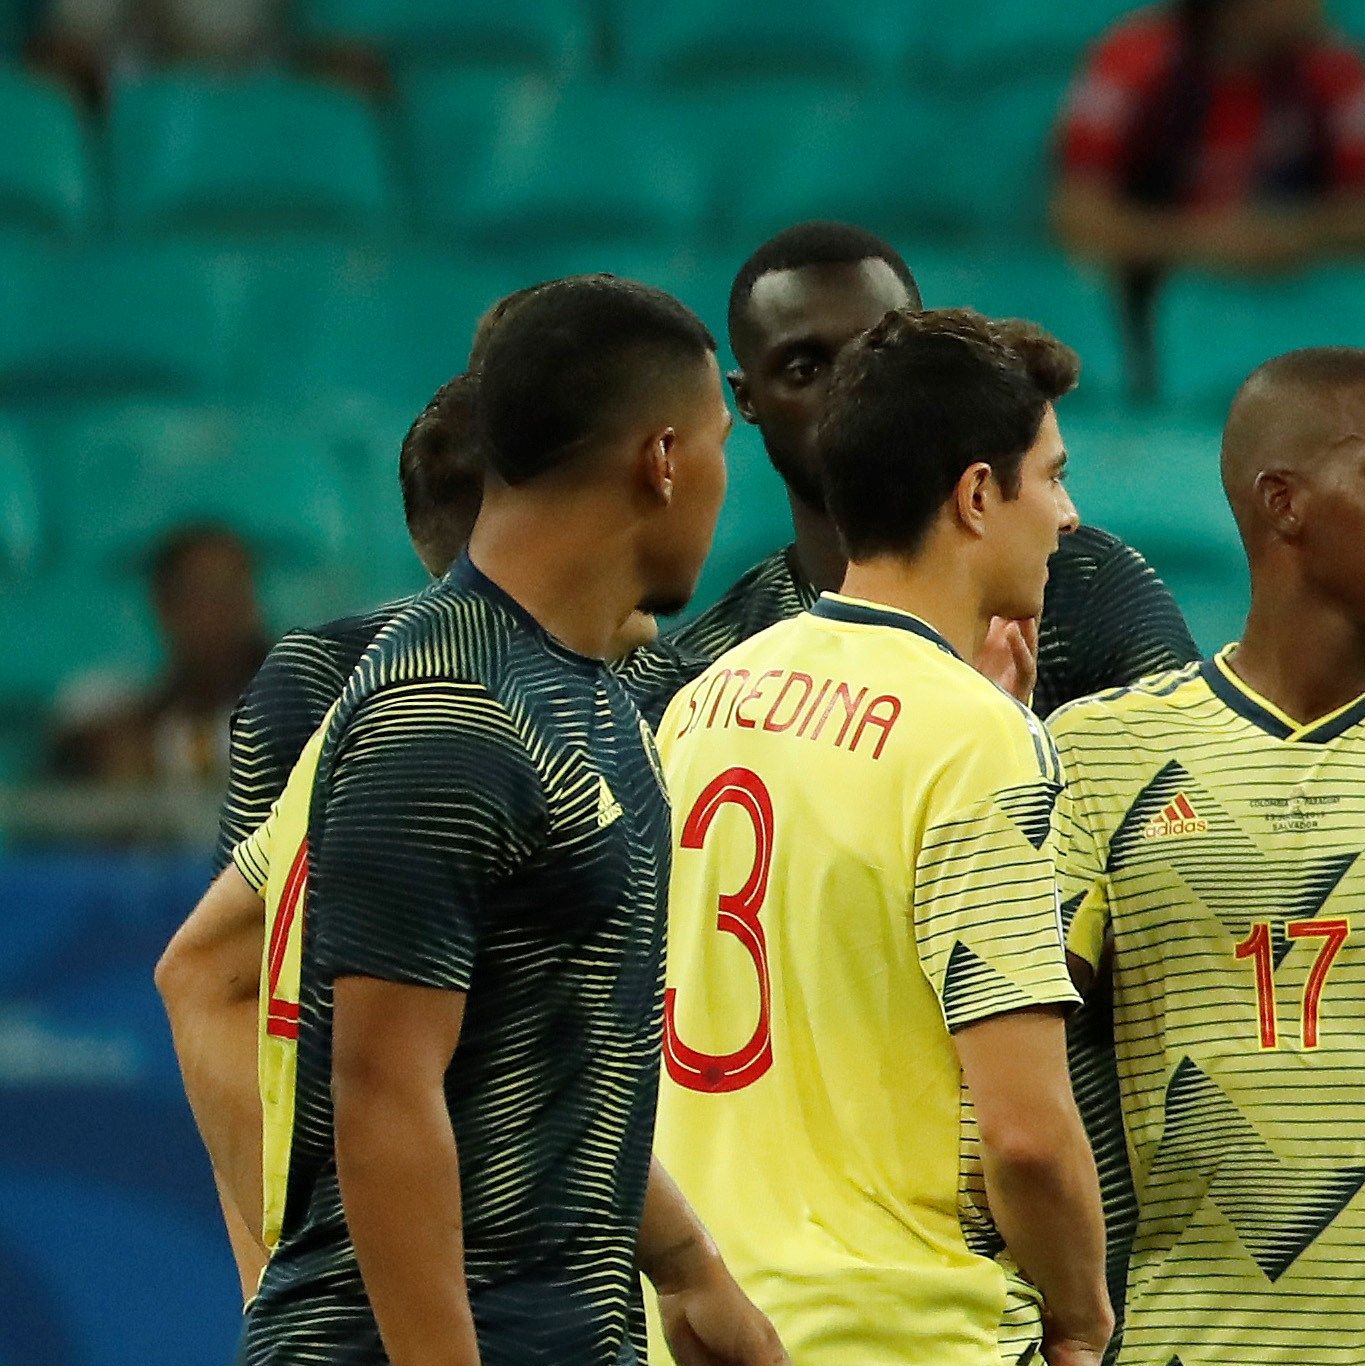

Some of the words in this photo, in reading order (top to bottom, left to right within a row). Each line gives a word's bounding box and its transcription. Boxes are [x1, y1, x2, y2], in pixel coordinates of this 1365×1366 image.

[1144, 818, 1208, 838] adidas
[663, 767, 774, 1093] 3
[1234, 918, 1350, 1051] 17
